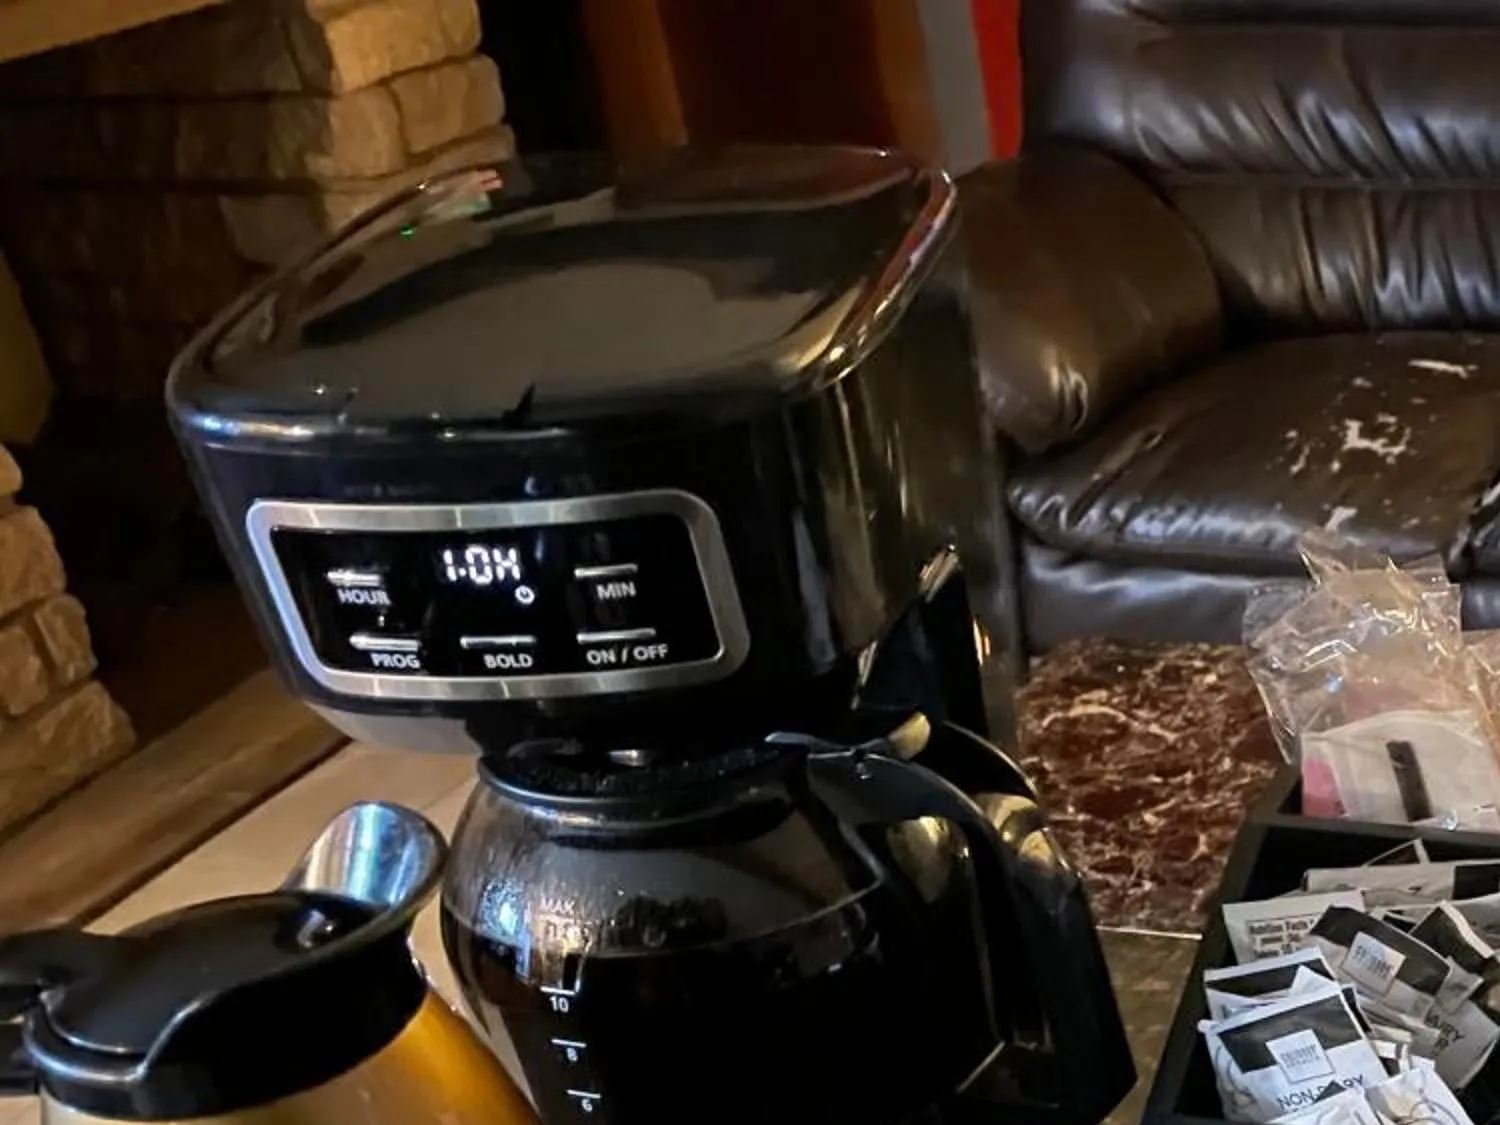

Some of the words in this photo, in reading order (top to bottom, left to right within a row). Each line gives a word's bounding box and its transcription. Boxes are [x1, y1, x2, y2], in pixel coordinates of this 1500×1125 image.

[337, 588, 391, 606] HOUR
[597, 581, 637, 600] MIN
[371, 653, 421, 669] PROG
[483, 653, 533, 669] BOLD
[586, 649, 617, 665] ON
[633, 643, 668, 661] OFF
[550, 996, 569, 1013] 10
